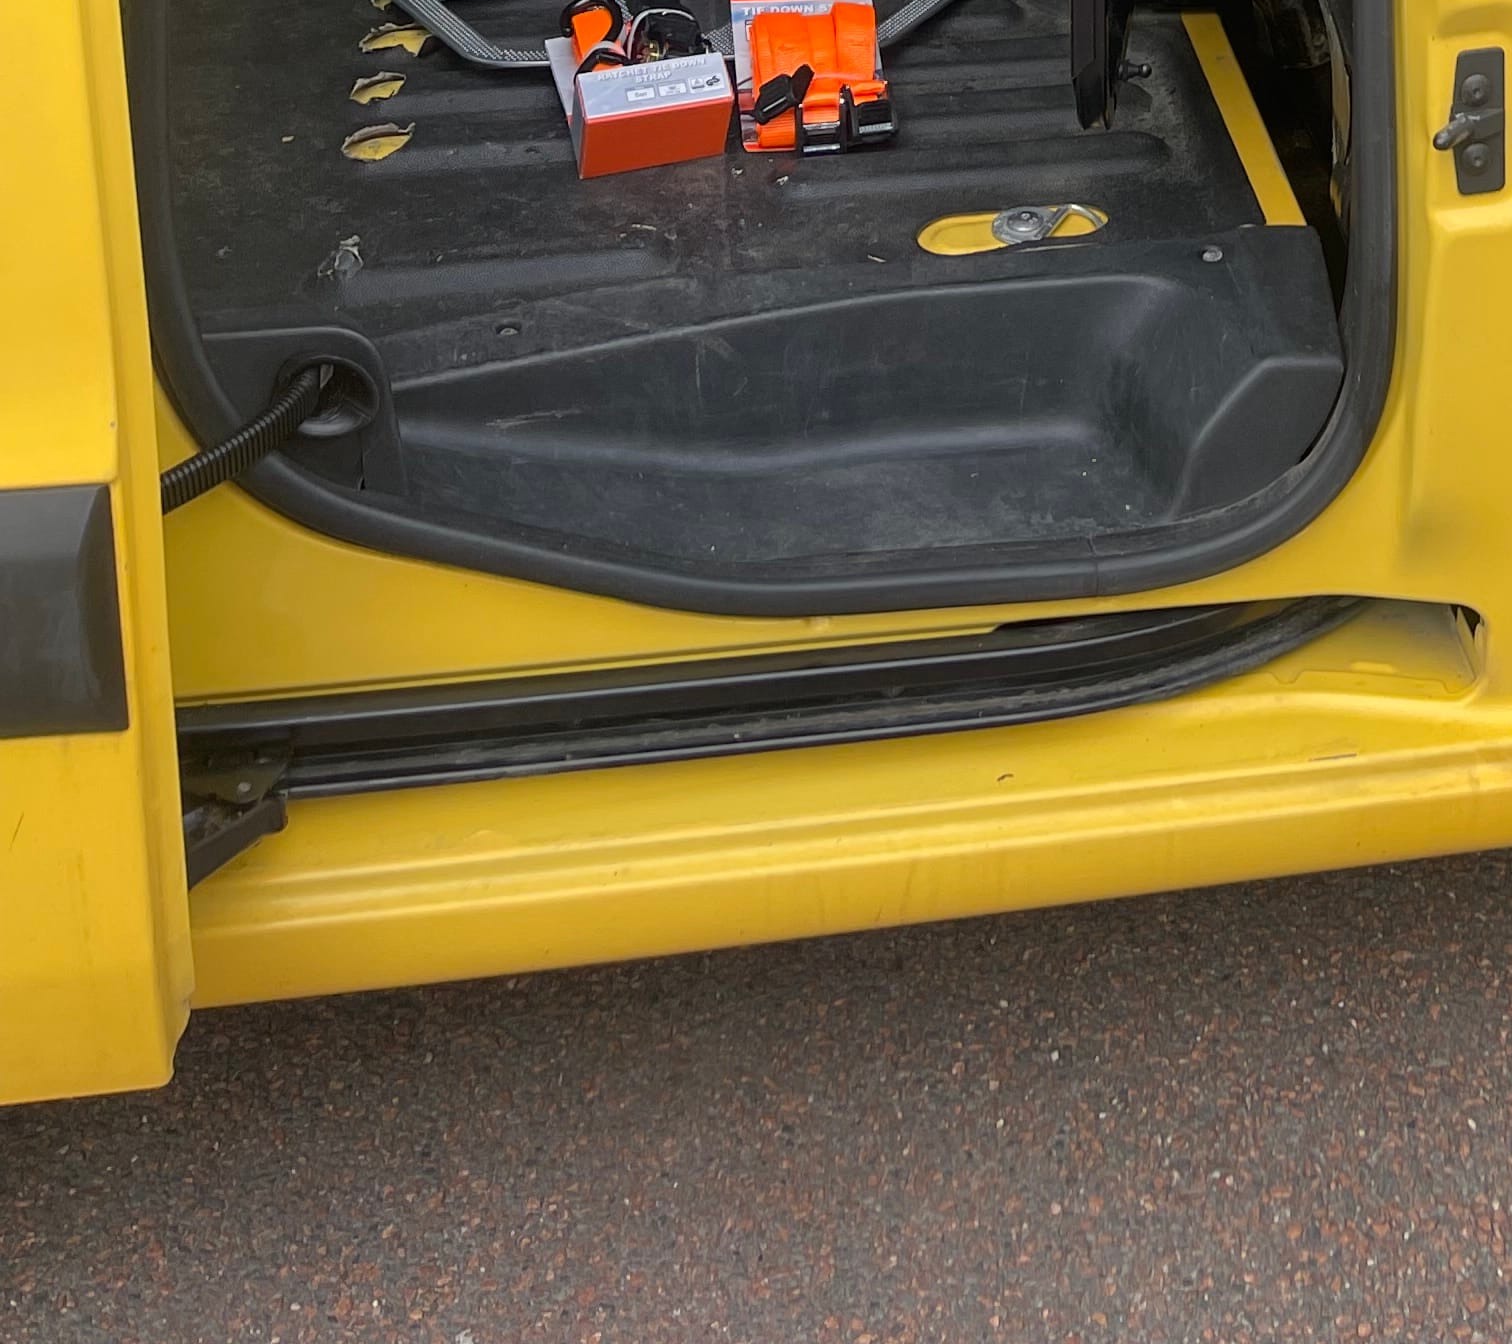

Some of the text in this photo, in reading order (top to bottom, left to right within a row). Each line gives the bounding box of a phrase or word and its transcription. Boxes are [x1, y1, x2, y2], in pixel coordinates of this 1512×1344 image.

[770, 4, 814, 13] DOWN
[597, 58, 706, 81] RATCHET TIE DOWN
[635, 70, 672, 83] STRAP
